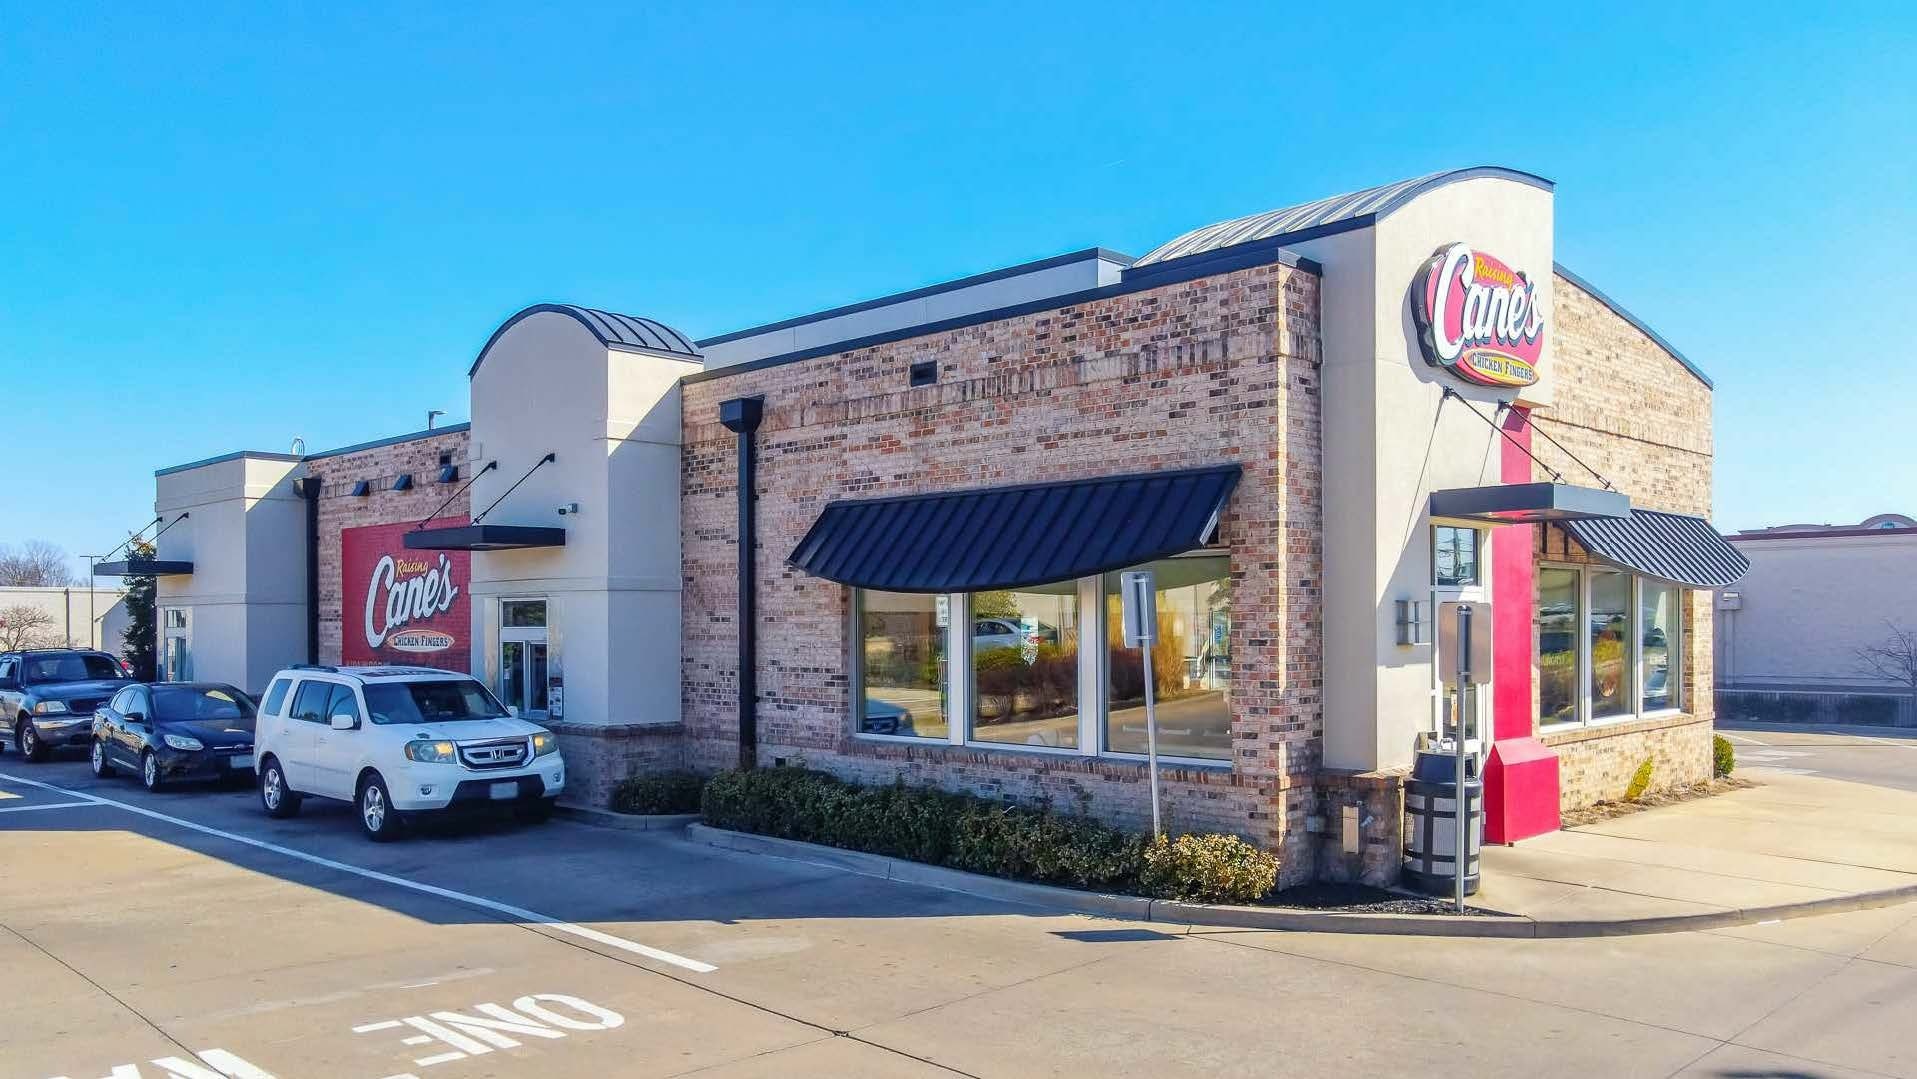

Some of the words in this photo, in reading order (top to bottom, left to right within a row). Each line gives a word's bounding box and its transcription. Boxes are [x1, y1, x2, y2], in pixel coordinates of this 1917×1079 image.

[1475, 256, 1514, 290] Raising
[1433, 241, 1544, 361] Cane's
[1472, 352, 1503, 373] CHICKEN
[1505, 361, 1533, 381] FINGERS
[396, 558, 429, 578] Raising
[365, 553, 459, 648] Cane's
[393, 636, 419, 647] CHICKEN
[421, 635, 449, 647] FINGERS
[351, 993, 625, 1067] ONE
